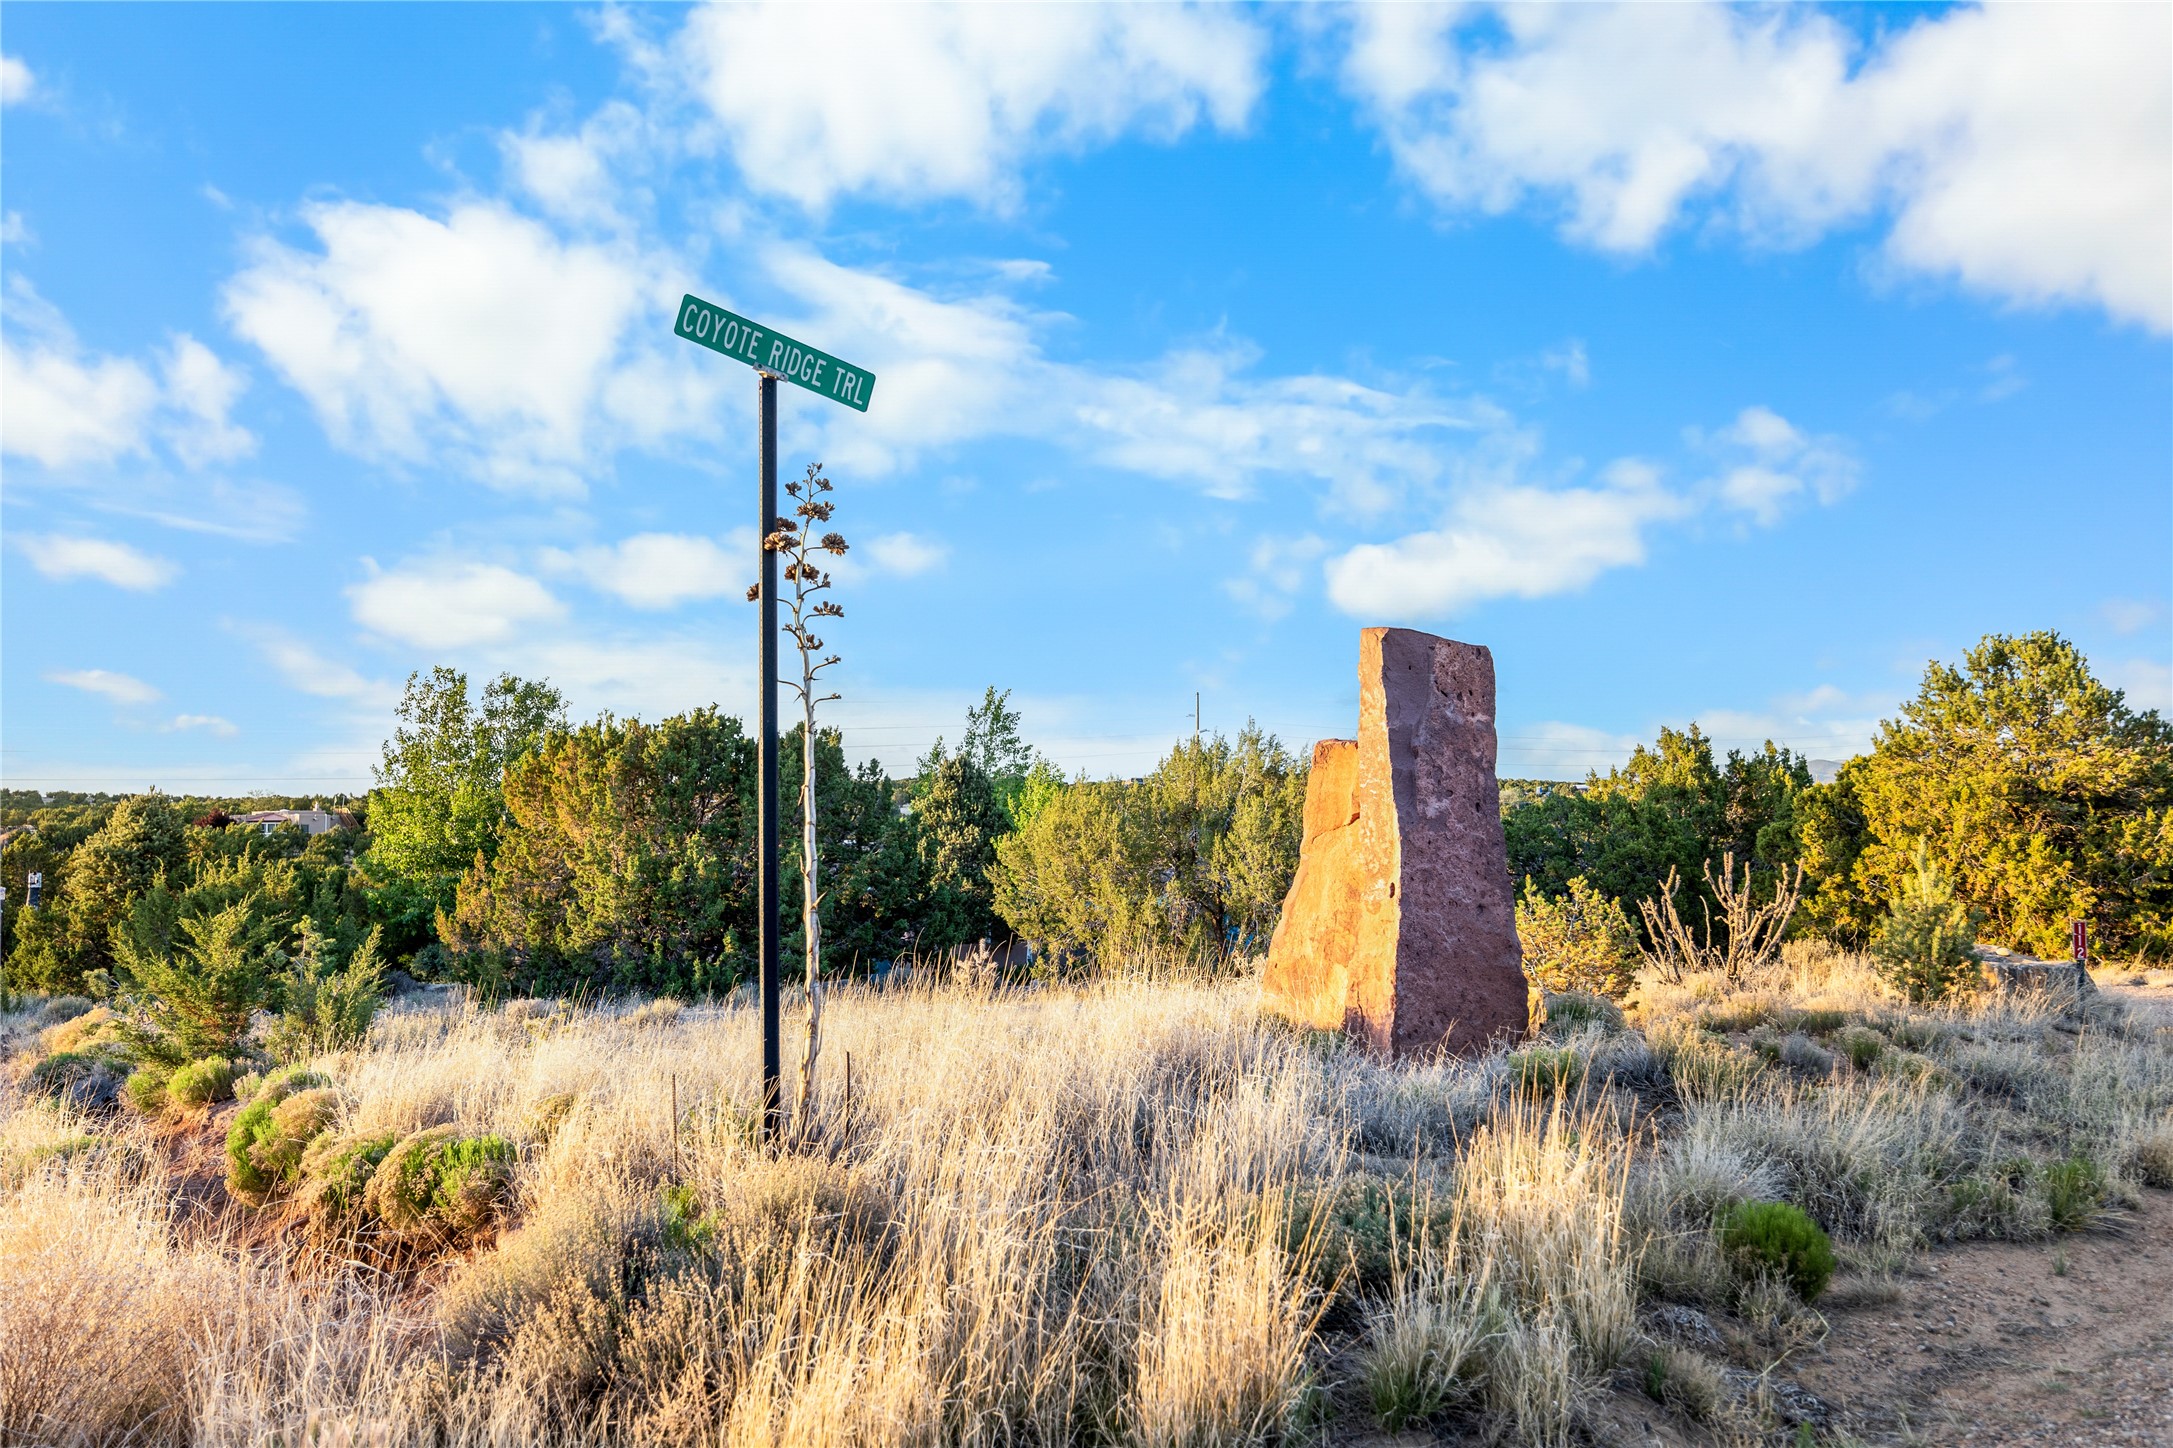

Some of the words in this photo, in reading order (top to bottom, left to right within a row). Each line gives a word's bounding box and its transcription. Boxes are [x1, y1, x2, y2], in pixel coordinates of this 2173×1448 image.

[682, 304, 763, 360] COYOTE
[767, 339, 827, 387] RIDGE
[832, 366, 863, 405] TRL
[2077, 923, 2085, 959] 112
